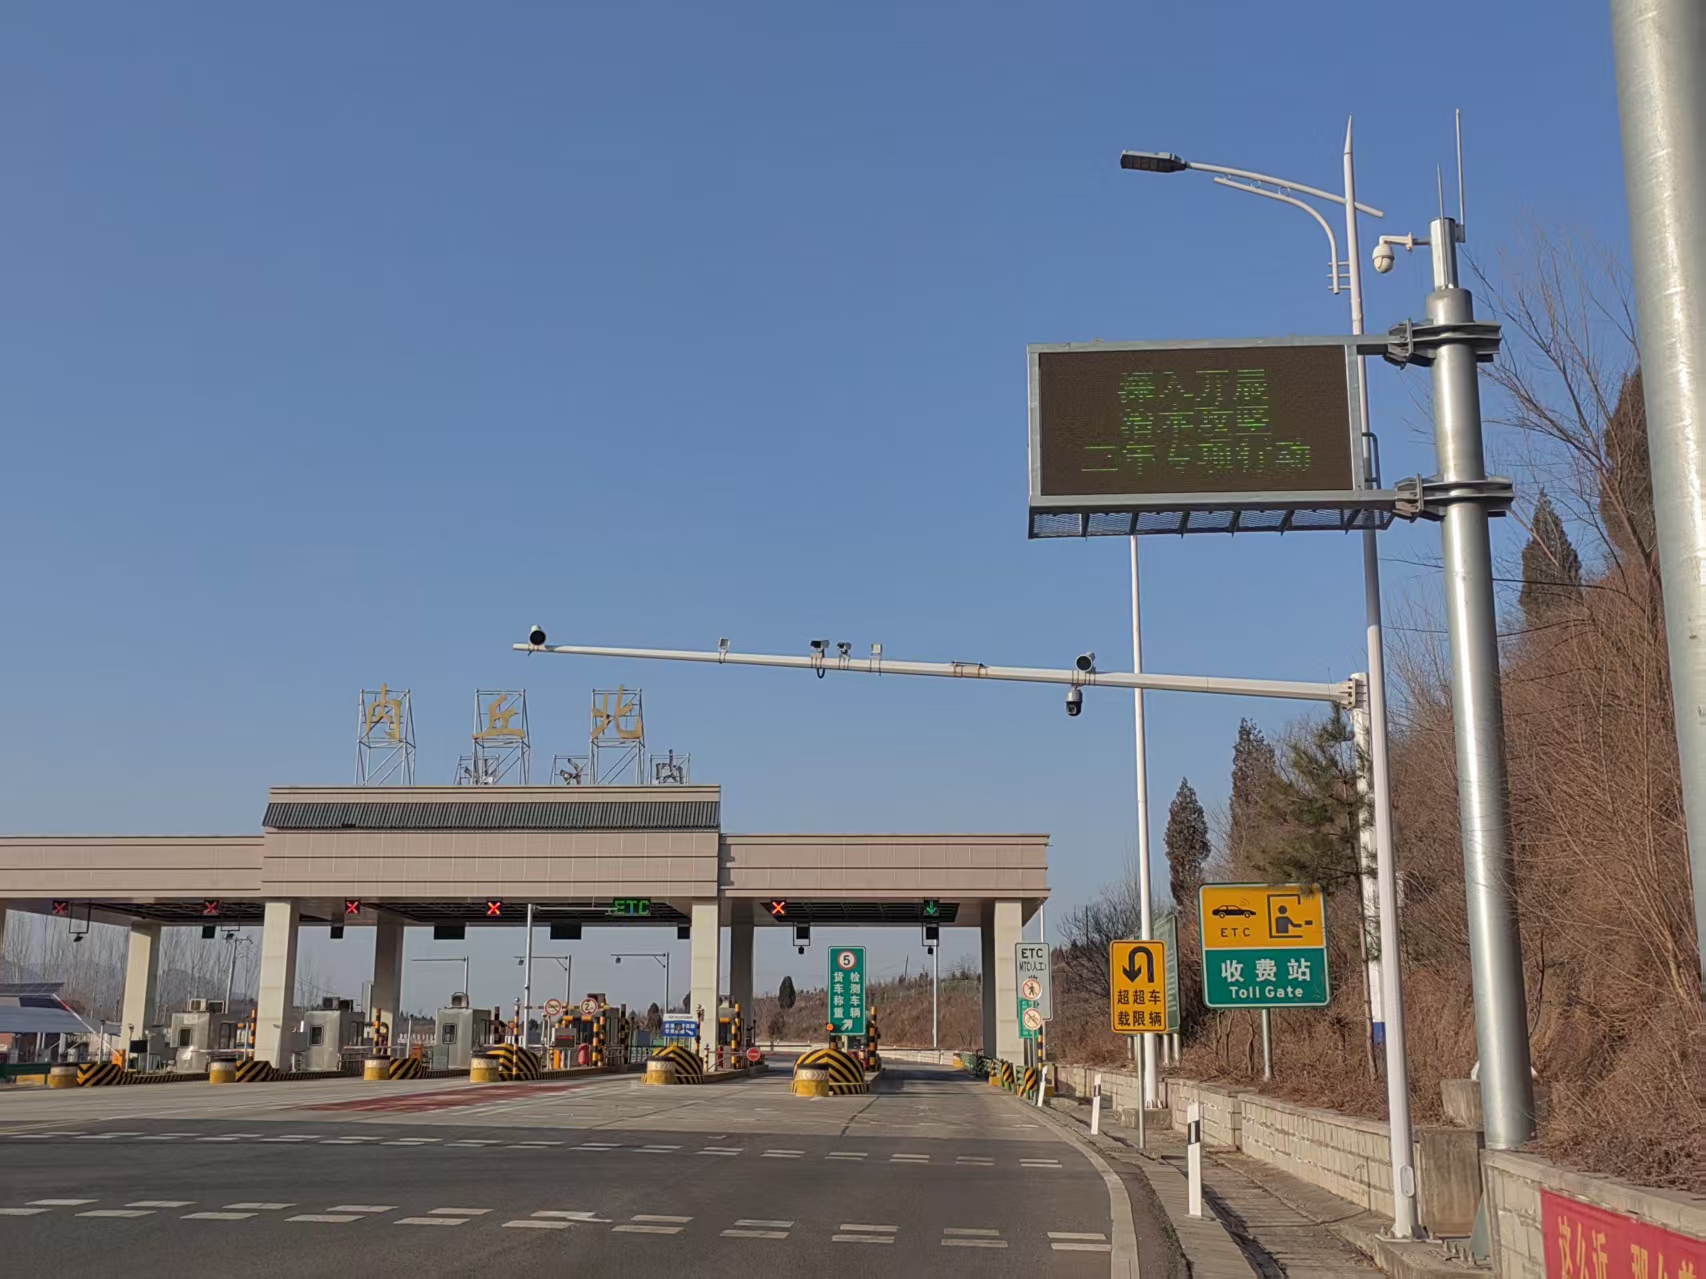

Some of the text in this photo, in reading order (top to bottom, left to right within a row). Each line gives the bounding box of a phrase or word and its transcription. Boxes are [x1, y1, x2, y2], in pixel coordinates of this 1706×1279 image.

[365, 682, 643, 742] 内丘北
[614, 899, 650, 916] ETC
[1220, 927, 1251, 938] ETC
[843, 955, 851, 966] 5
[1021, 947, 1044, 959] ETC
[1221, 957, 1311, 983] 收费站
[833, 971, 845, 1018] 货车称重
[849, 971, 861, 1019] 检测车辆
[1229, 985, 1304, 998] Toll Gate
